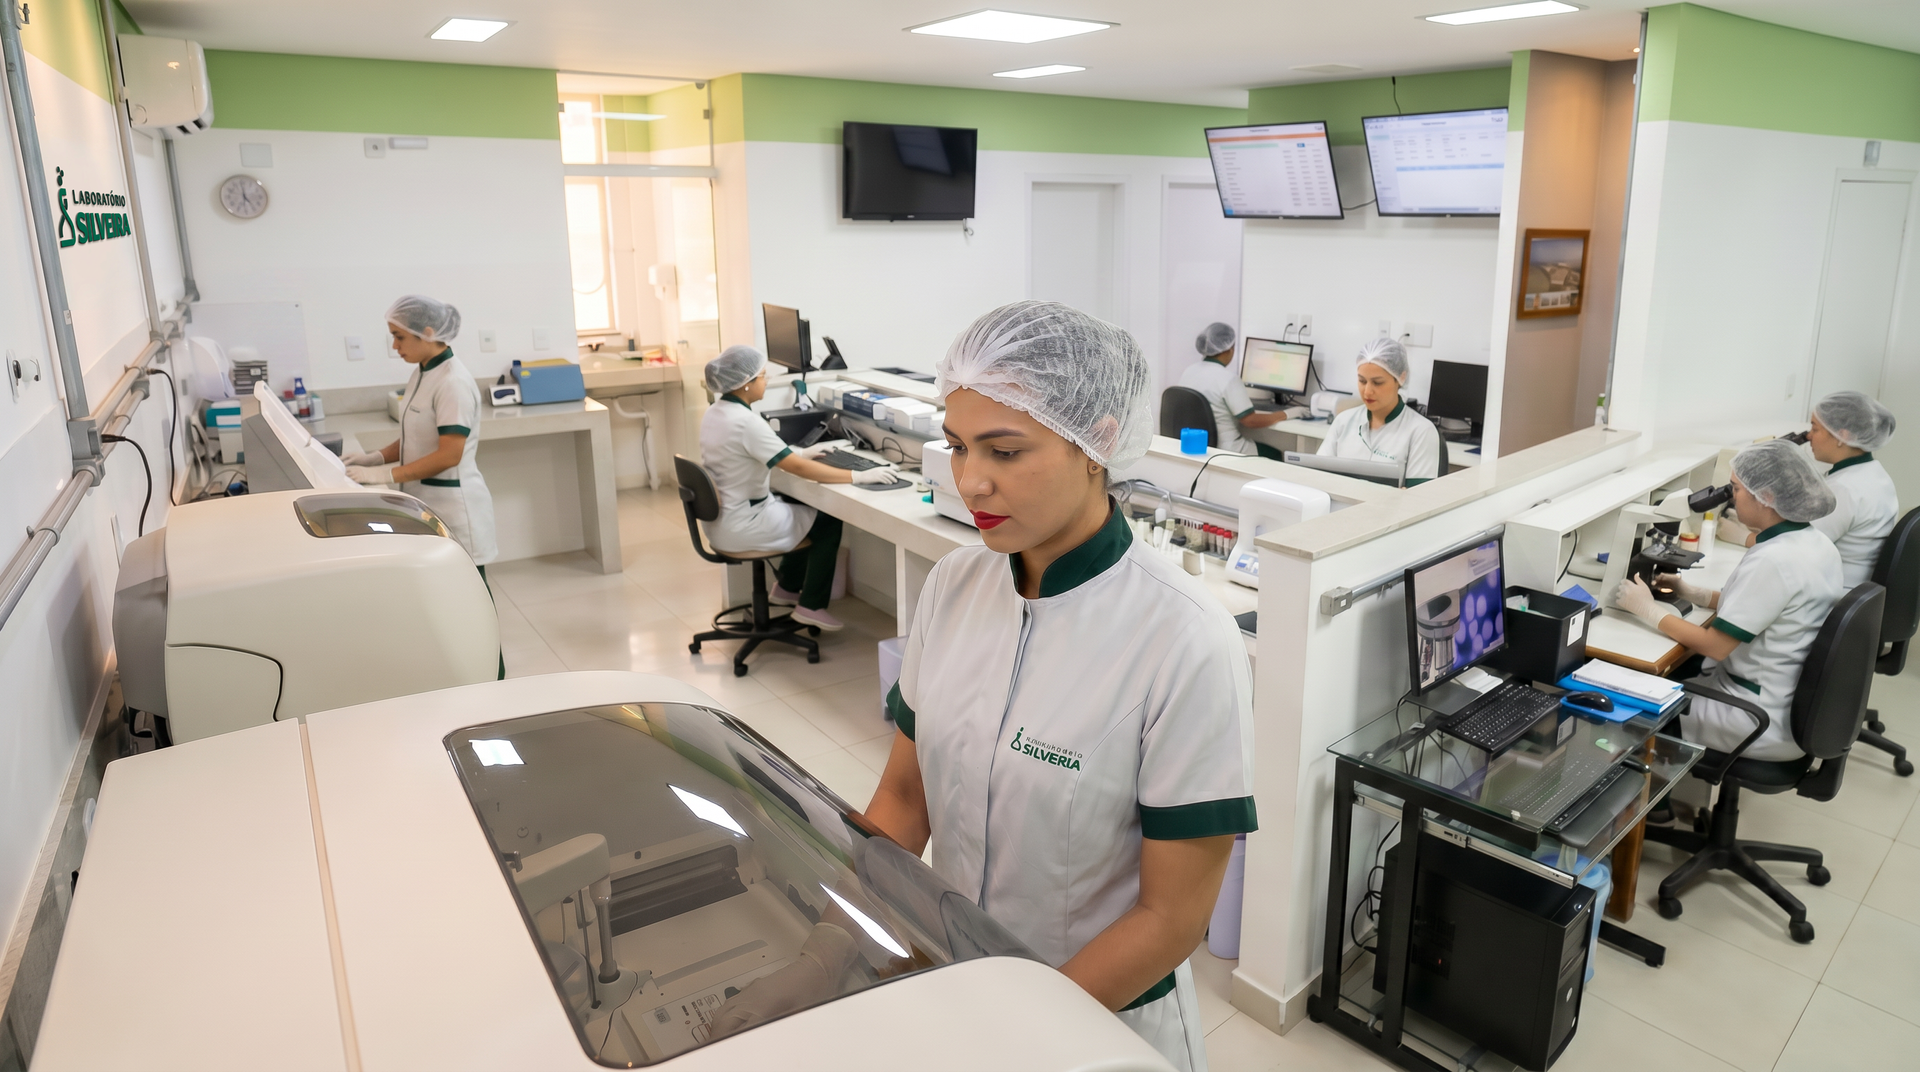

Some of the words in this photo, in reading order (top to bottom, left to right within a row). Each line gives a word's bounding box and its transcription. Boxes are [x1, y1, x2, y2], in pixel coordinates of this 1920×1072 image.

[71, 189, 126, 207] LABORATÓRIO
[76, 212, 131, 244] SILVEIRA
[1022, 743, 1080, 771] SILVERIA
